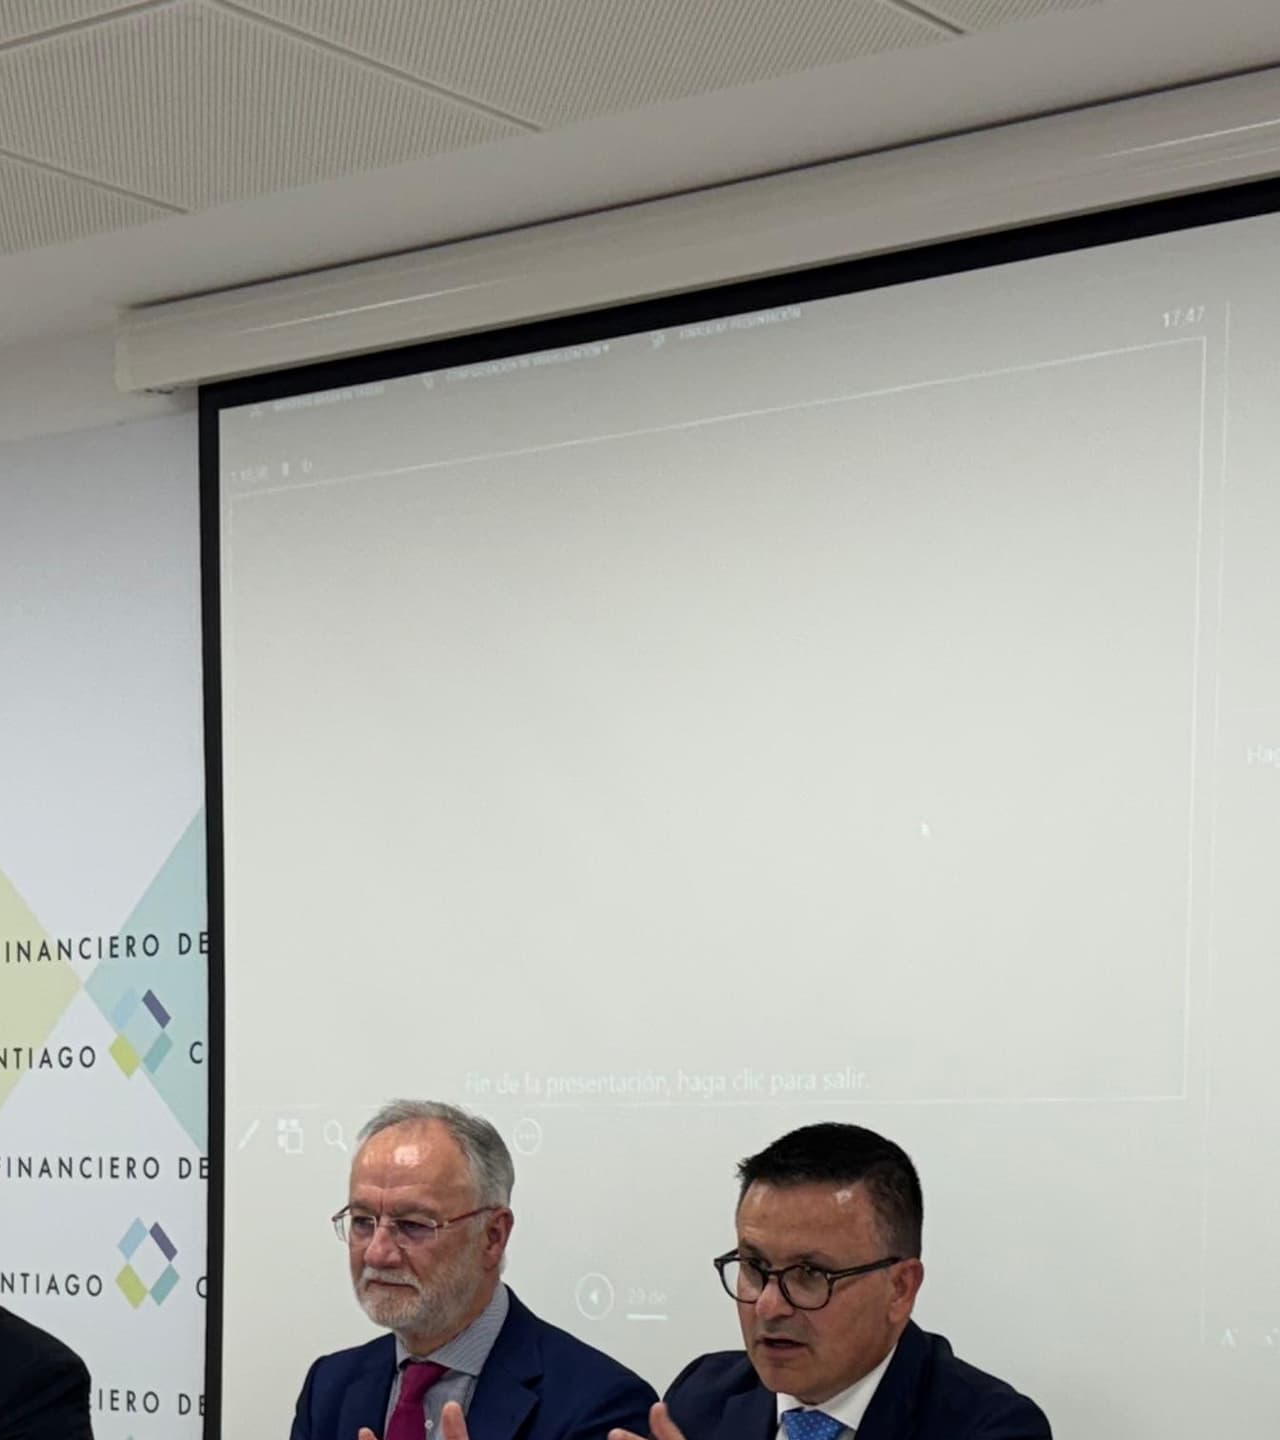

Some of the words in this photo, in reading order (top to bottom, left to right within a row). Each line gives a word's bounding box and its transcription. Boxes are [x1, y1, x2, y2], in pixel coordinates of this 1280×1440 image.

[178, 931, 208, 955] DE
[677, 1069, 726, 1098] haga
[732, 1066, 764, 1092] clic
[770, 1070, 817, 1096] para
[178, 1156, 208, 1179] DE
